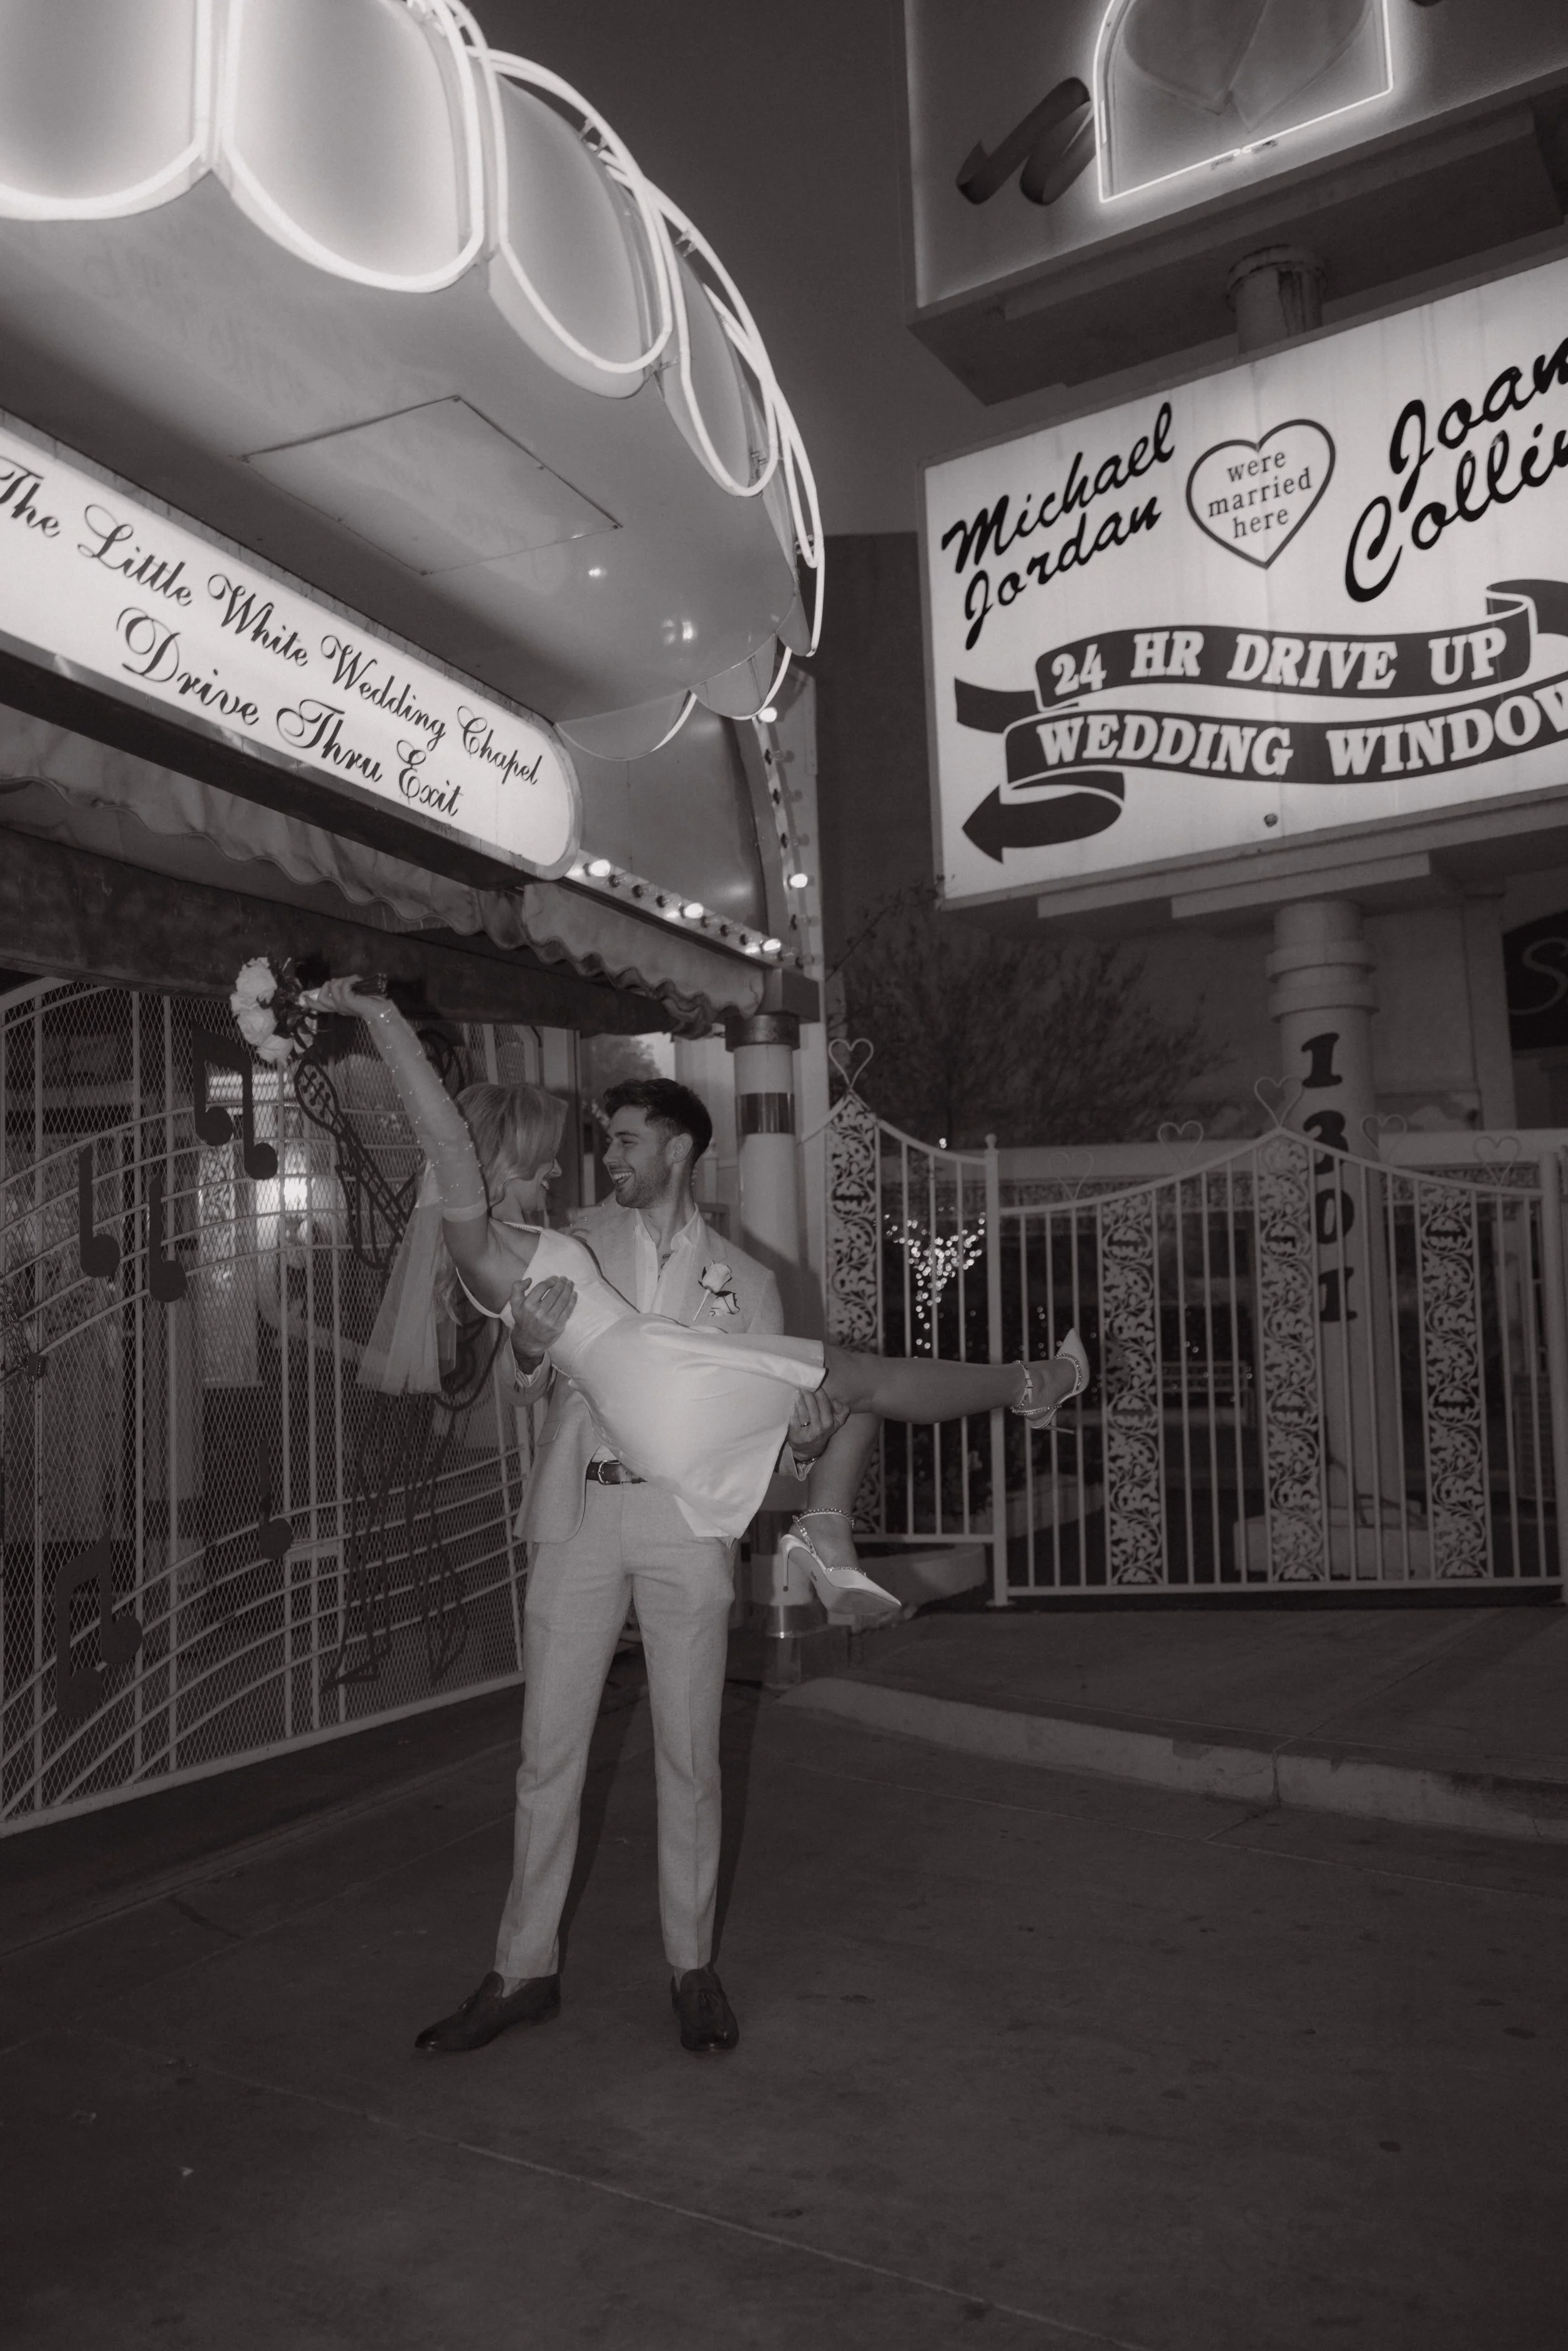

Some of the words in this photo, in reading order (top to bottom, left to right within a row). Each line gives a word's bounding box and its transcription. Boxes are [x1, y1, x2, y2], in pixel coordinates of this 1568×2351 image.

[941, 401, 1175, 574] Michael
[1208, 466, 1313, 517] married
[1227, 452, 1286, 483] were
[1232, 507, 1290, 539] here
[0, 455, 60, 538] The
[77, 504, 193, 606] Little
[208, 573, 309, 667] White
[320, 635, 447, 751] Wedding
[457, 706, 543, 785] Chapel
[964, 496, 1162, 650] Jordan
[116, 607, 260, 726] Drive
[276, 699, 383, 783] Thru
[396, 740, 464, 817] Exit
[1051, 643, 1107, 696] 24
[1130, 630, 1205, 679] HR
[1226, 632, 1398, 690] DRIVE
[1428, 627, 1507, 686] UP
[1036, 713, 1295, 775] WEDDING
[1301, 1032, 1358, 1323] 1301
